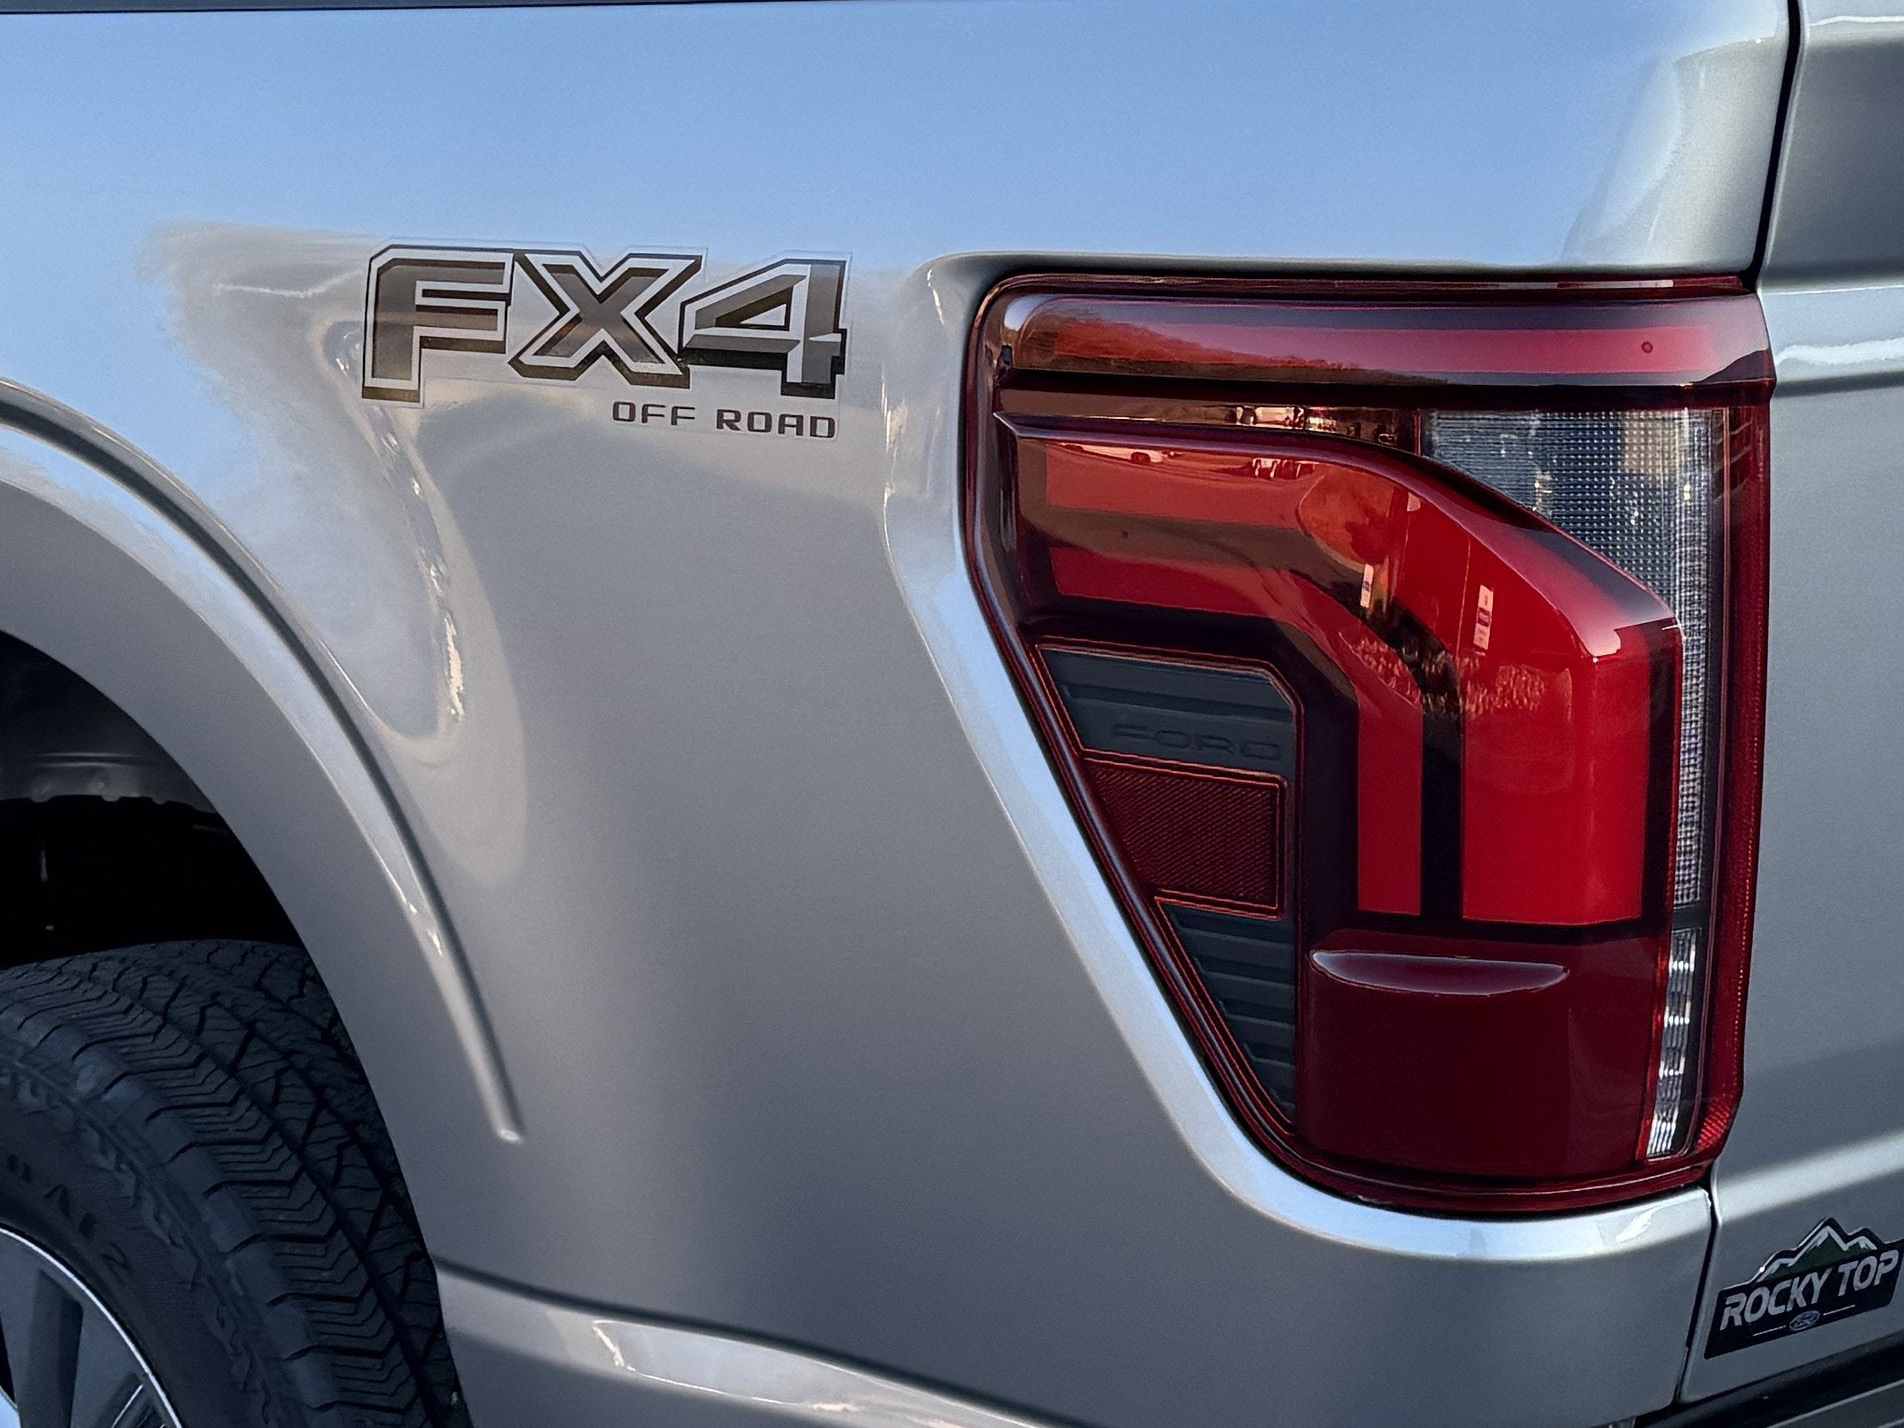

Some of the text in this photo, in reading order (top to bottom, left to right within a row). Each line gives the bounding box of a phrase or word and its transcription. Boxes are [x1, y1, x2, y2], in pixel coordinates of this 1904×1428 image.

[361, 243, 849, 401] FX4
[612, 401, 837, 439] OFF ROAD
[1719, 1249, 1900, 1331] ROCKY TOP
